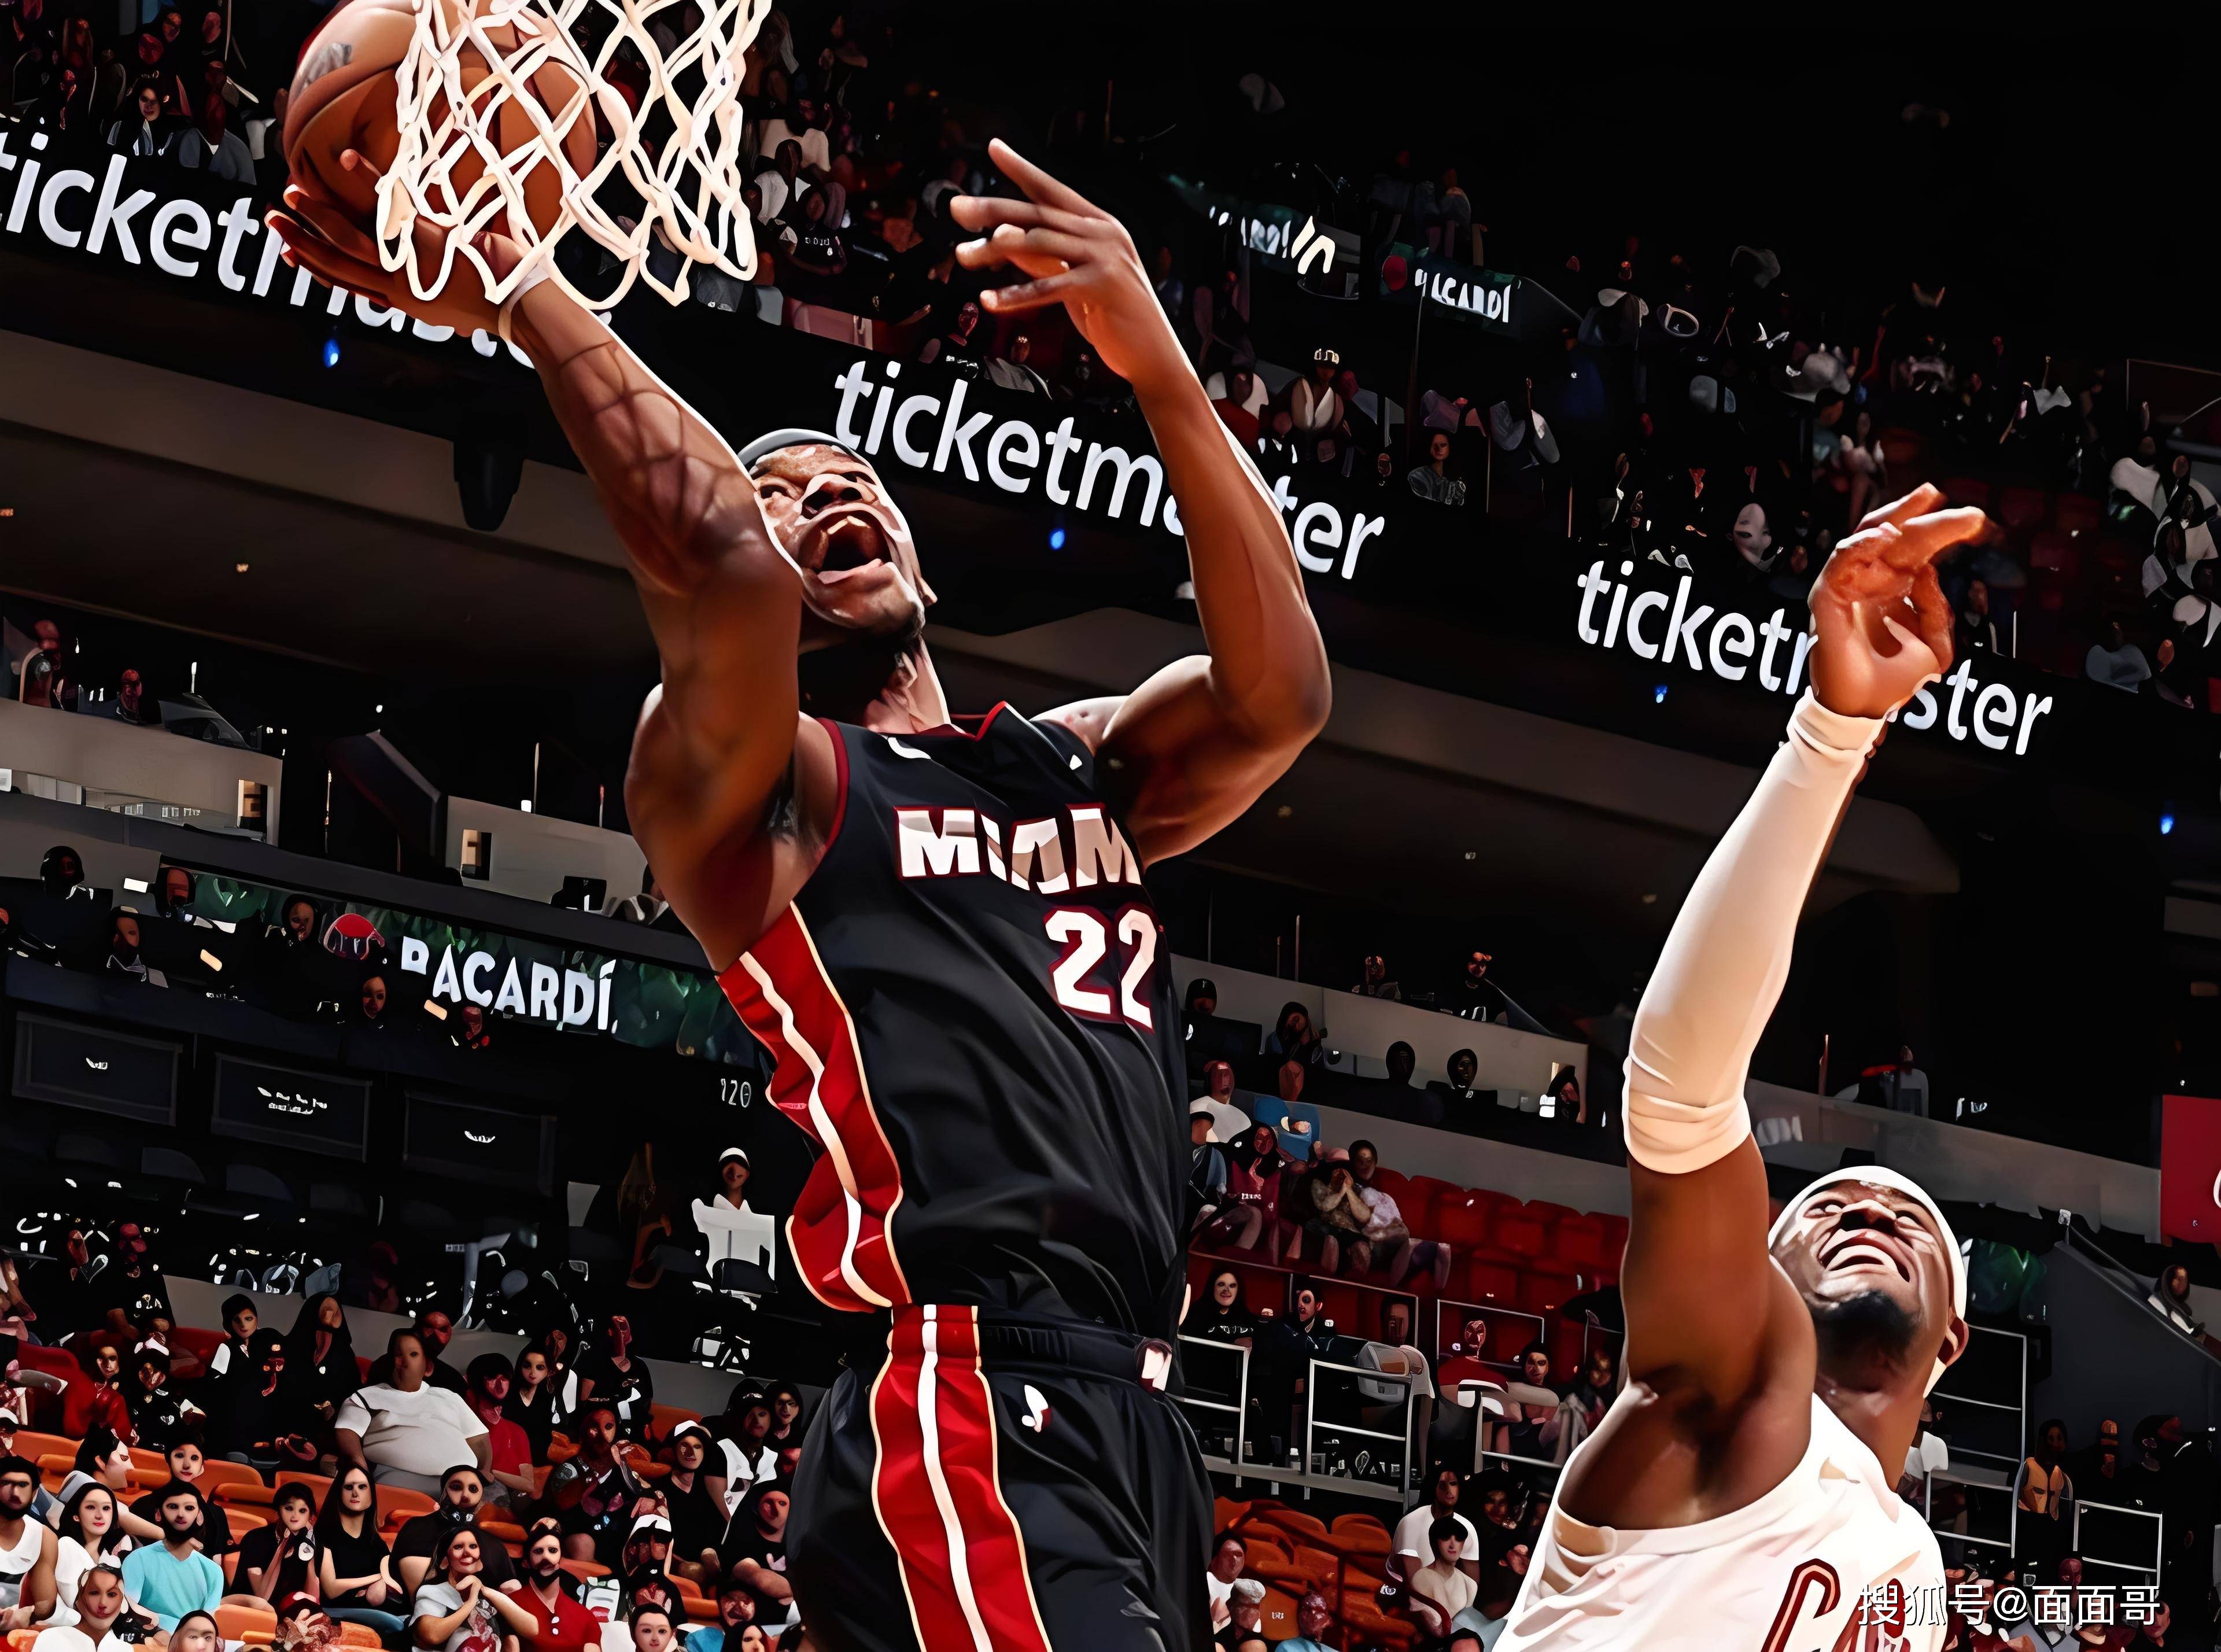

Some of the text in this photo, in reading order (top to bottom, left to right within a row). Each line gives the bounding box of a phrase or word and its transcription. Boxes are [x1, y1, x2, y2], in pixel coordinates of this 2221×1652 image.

[835, 360, 1385, 580] ticketmer
[1578, 560, 2053, 755] ticketster
[1046, 909, 1157, 1029] 22
[721, 1078, 752, 1108] 120
